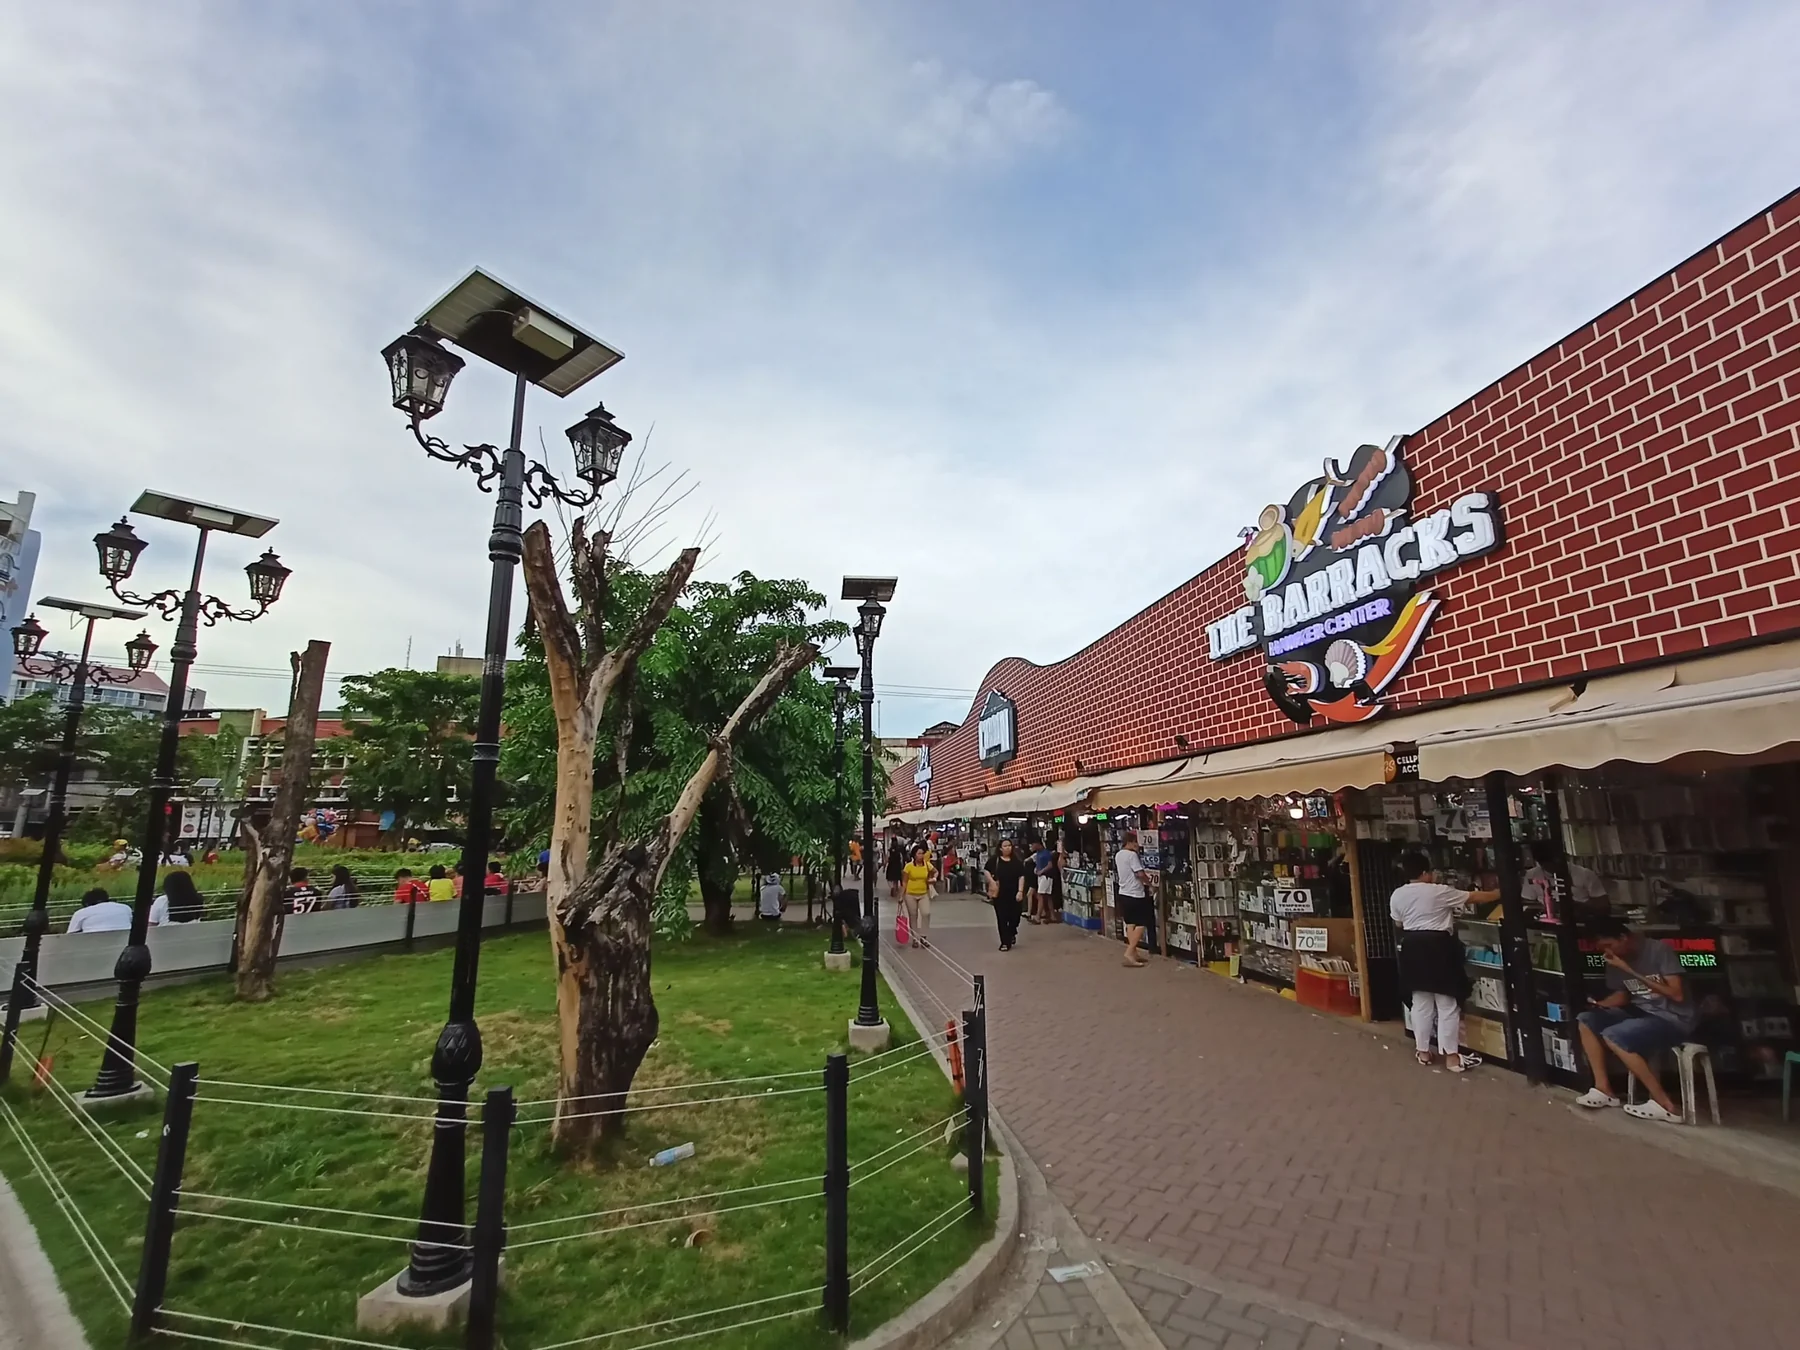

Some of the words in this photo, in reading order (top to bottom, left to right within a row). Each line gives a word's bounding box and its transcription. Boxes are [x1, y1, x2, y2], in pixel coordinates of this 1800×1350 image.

[1205, 606, 1258, 659] THE
[1260, 492, 1496, 636] BARRACKS
[1268, 623, 1326, 657] HAWKER
[1324, 598, 1393, 636] CENTER
[1143, 835, 1153, 844] 70
[1278, 890, 1308, 903] 70
[293, 896, 317, 914] 57
[1298, 936, 1314, 948] 70
[1679, 954, 1717, 967] REPAIR
